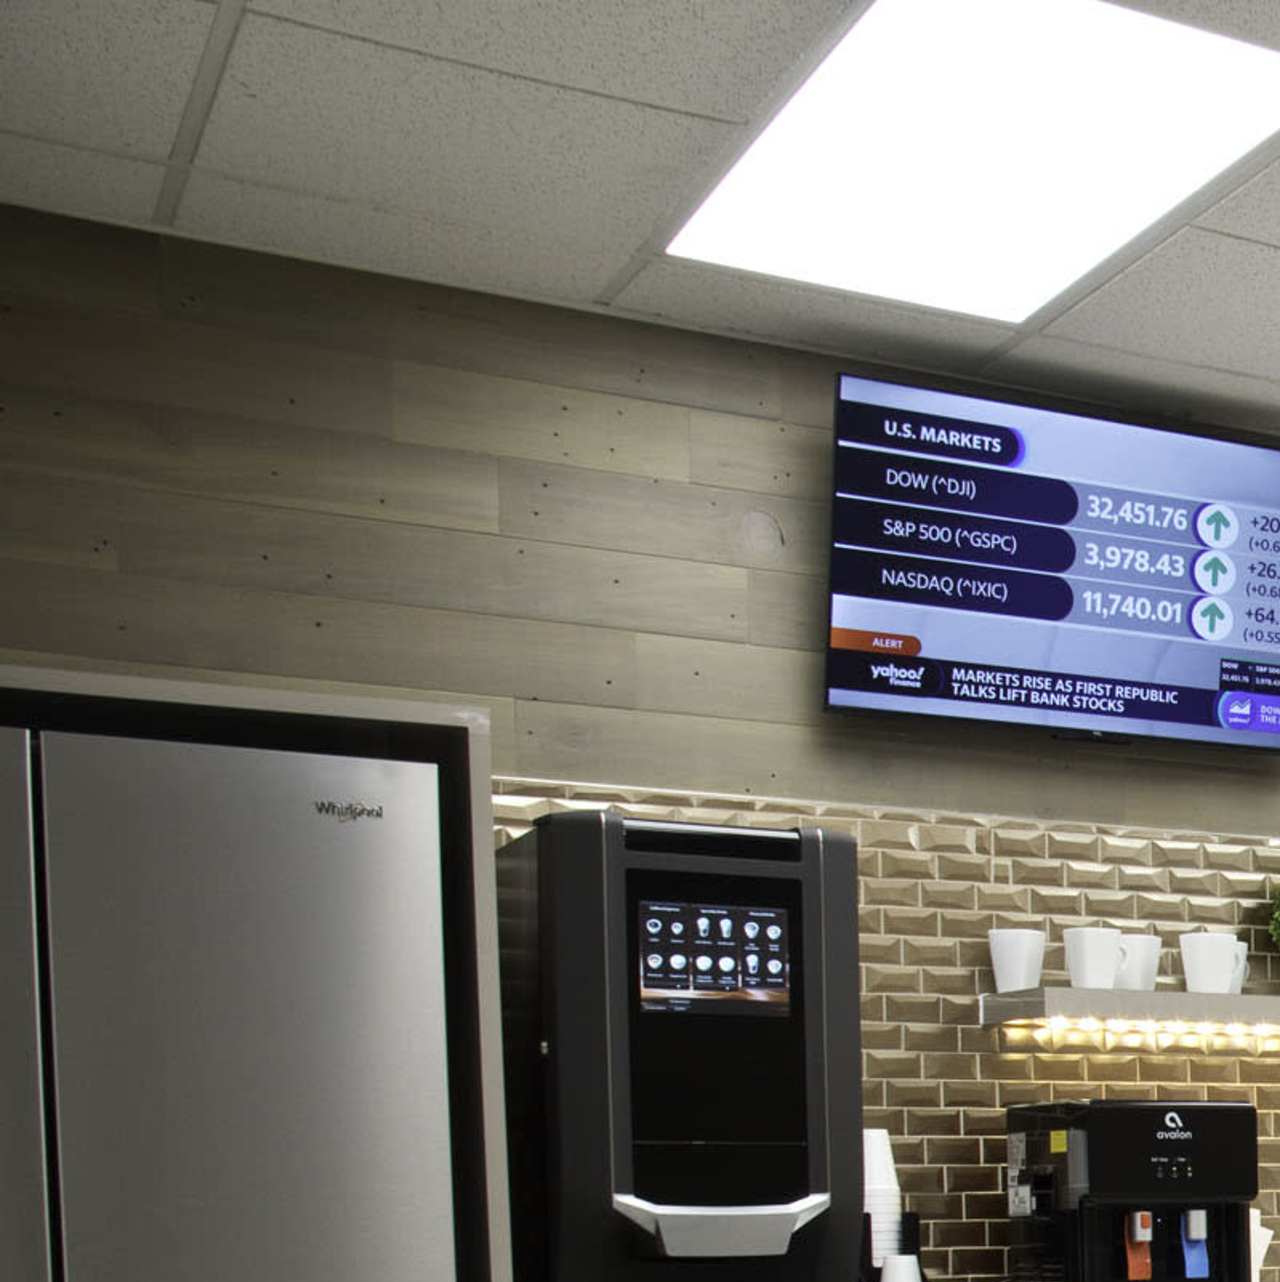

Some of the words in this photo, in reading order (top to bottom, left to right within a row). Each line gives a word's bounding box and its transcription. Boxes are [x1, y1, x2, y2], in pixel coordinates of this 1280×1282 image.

[884, 419, 917, 439] U.S.
[920, 426, 1001, 453] MARKETS
[886, 468, 928, 489] DOW
[932, 474, 977, 500] (^DJI)
[1086, 495, 1188, 530] 32,451.76
[883, 518, 916, 538] S&P
[919, 524, 951, 543] 500
[955, 528, 1017, 555] (^GSPC)
[1084, 542, 1185, 577] 3,978.43
[882, 569, 954, 596] NASDAQ
[957, 578, 1008, 602] (^IXIC)
[1082, 590, 1183, 624] 11,740.01
[872, 637, 903, 649] ALERT
[871, 663, 925, 681] yahoo!
[889, 675, 922, 689] finance
[952, 668, 1020, 688] MARKETS
[1023, 675, 1052, 691] RISE
[1055, 677, 1074, 693] AS
[1075, 680, 1113, 697] FIRST
[1114, 684, 1178, 705] REPUBLIC
[952, 682, 996, 700] TALKS
[999, 687, 1028, 703] LIFT
[1031, 690, 1070, 708] BANK
[1072, 694, 1125, 714] STOCKS
[1261, 714, 1277, 724] THE
[315, 800, 384, 821] Whirlpool
[1156, 1128, 1193, 1140] avalon
